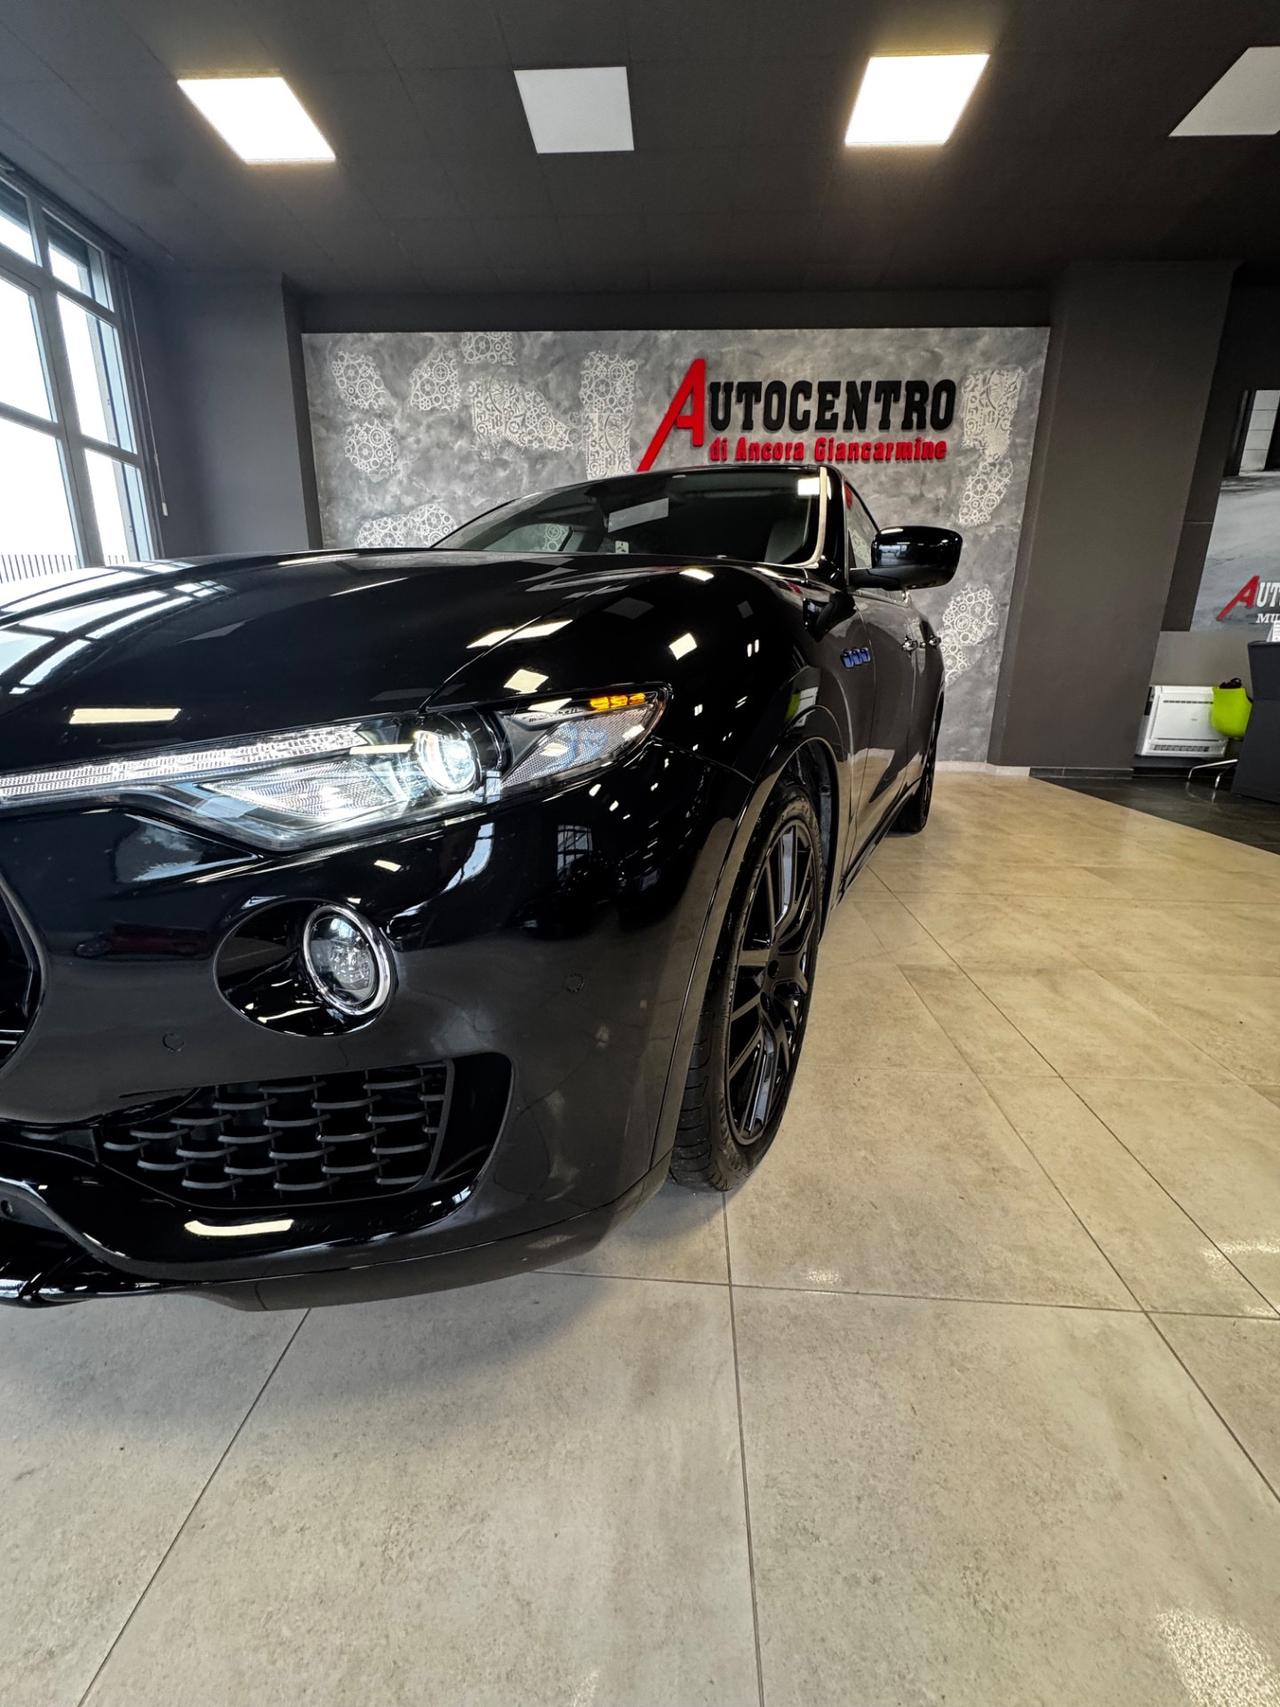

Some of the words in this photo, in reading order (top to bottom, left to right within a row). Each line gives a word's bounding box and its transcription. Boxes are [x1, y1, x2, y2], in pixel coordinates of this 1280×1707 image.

[637, 358, 956, 472] AUTOCENTRO
[710, 437, 728, 462] di
[735, 437, 805, 461] Ancora
[814, 436, 948, 462] Giancarmine
[1215, 575, 1280, 622] AUT
